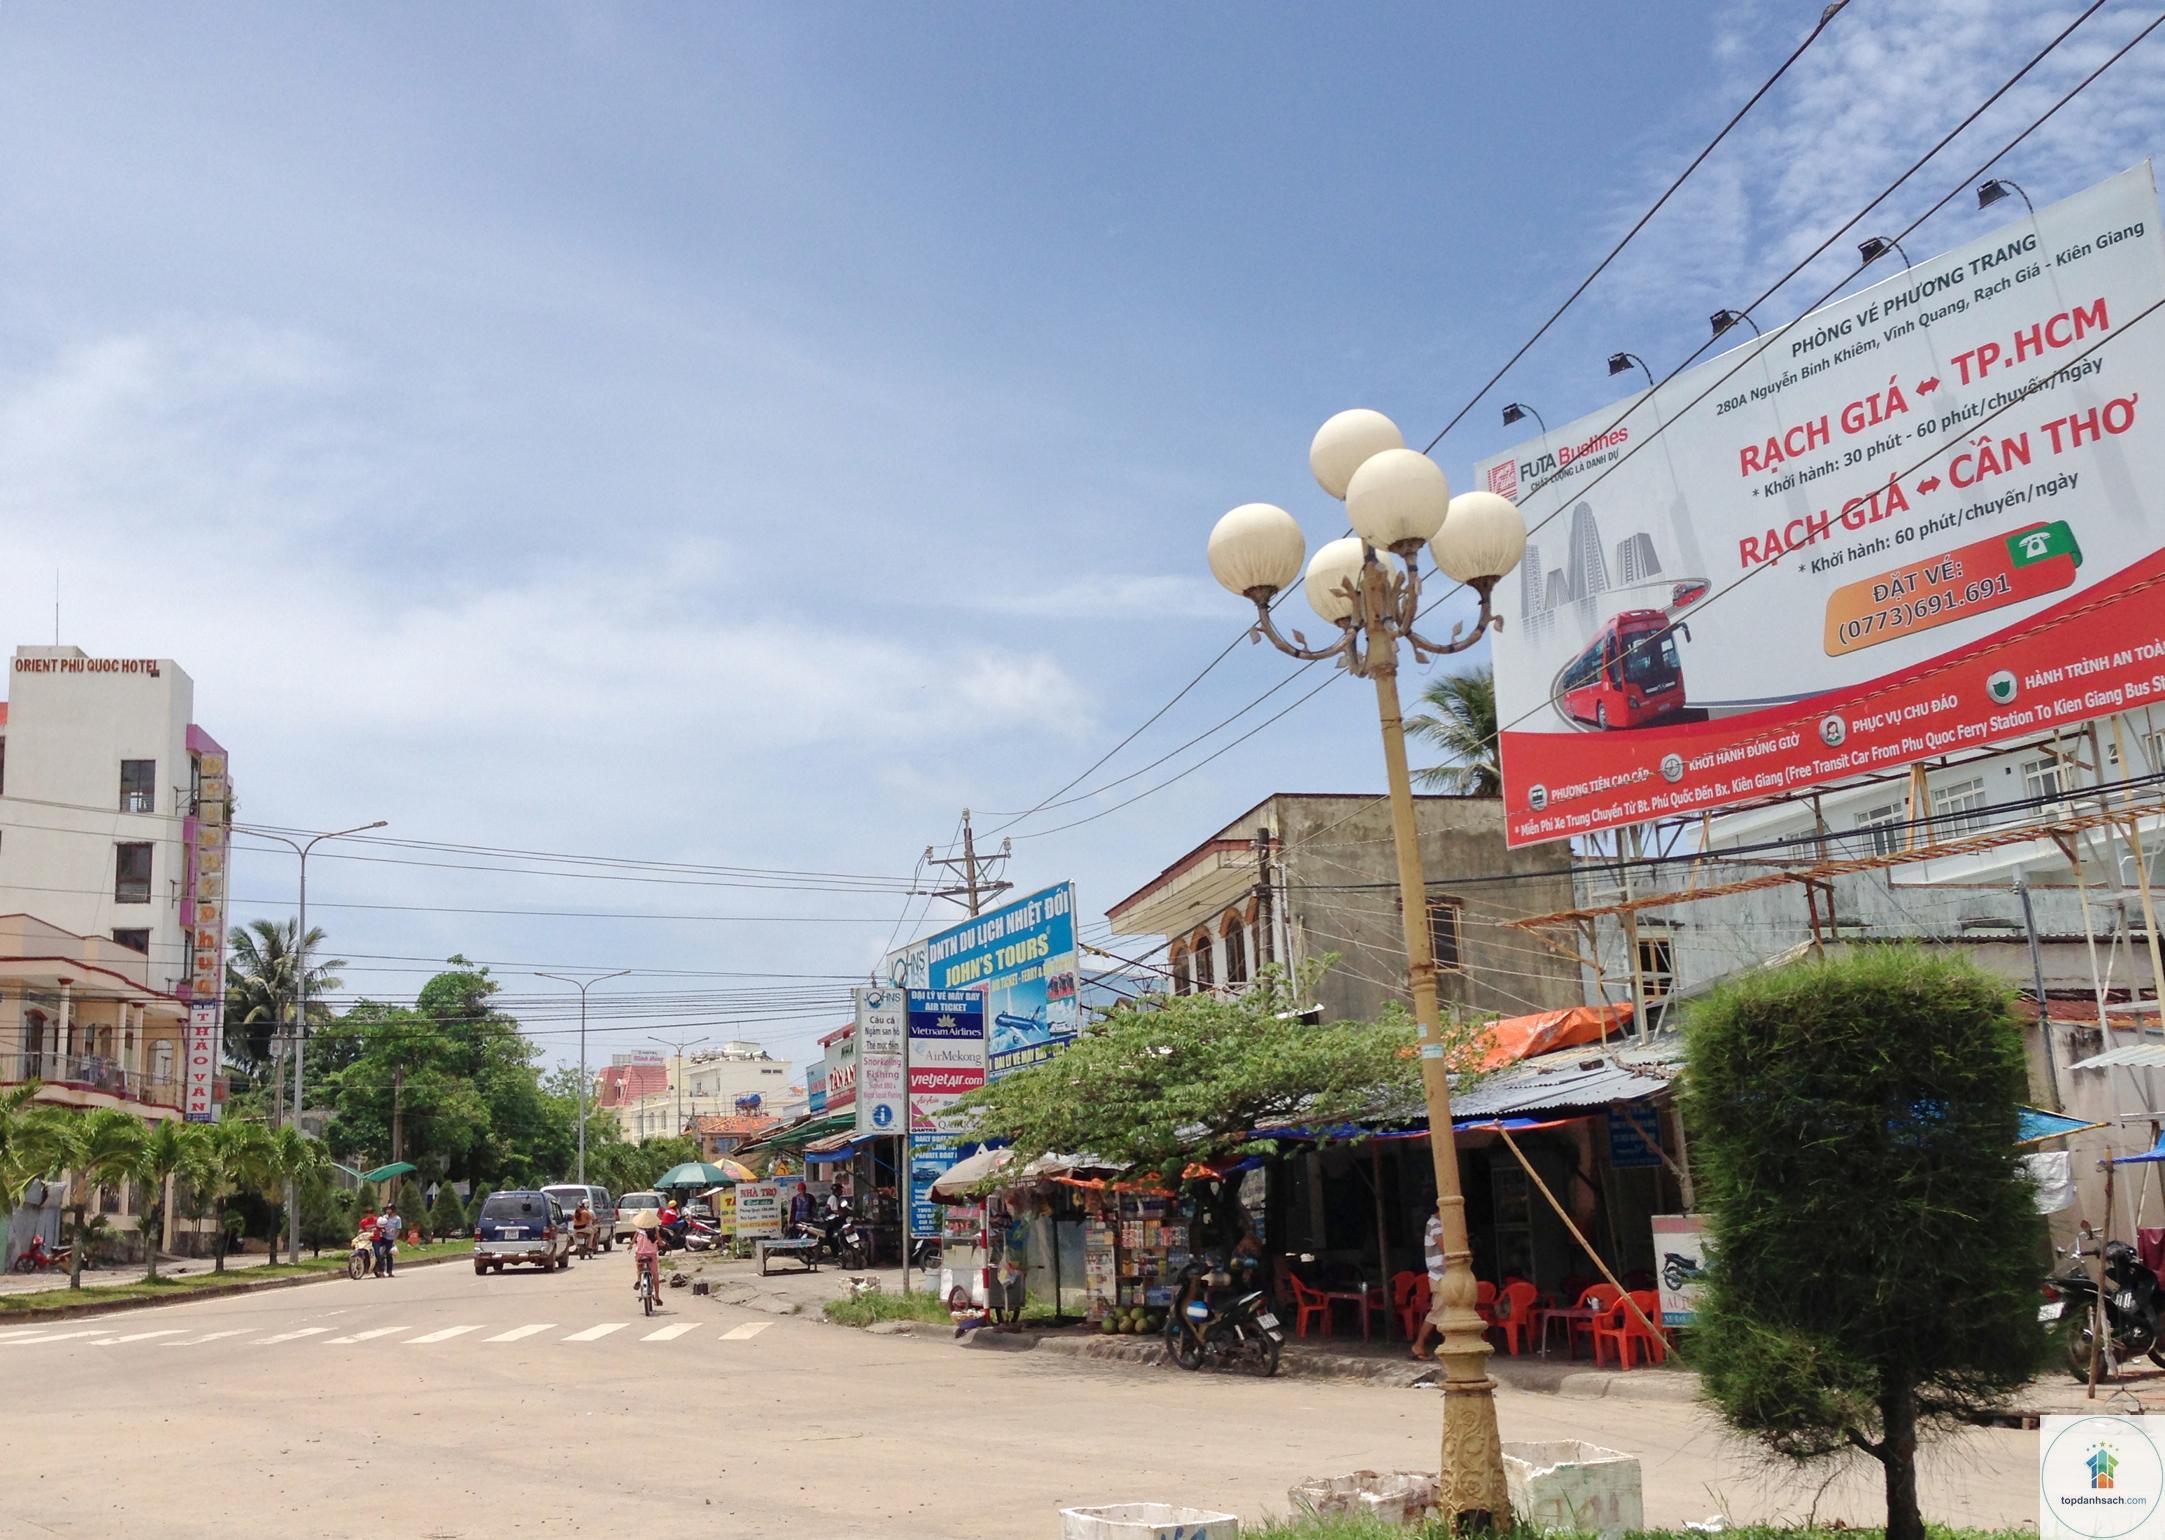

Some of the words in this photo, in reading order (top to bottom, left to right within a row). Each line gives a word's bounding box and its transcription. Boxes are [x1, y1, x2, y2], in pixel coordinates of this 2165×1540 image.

[1715, 393, 1748, 416] 280A
[1750, 370, 1798, 402] Nguyễn
[1834, 340, 1880, 366] Khiêm,
[1918, 298, 1970, 328] Quang,
[1974, 276, 2011, 303] Rạch
[2015, 262, 2041, 284] Giá
[2056, 243, 2092, 267] Kiên
[2095, 222, 2145, 250] Giang
[1792, 318, 1852, 358] PHÒNG
[1856, 301, 1879, 328] VÉ
[1883, 268, 1964, 317] PHƯƠNG
[1969, 233, 2037, 277] TRANG
[1739, 415, 1831, 478] RẠCH
[1840, 373, 1909, 435] GIÁ
[1951, 297, 2110, 386] TP.HCM
[1520, 453, 1557, 482] FUTA
[1558, 427, 1629, 467] Buslines
[1586, 454, 1607, 471] DANH
[1739, 509, 1831, 569] RẠCH
[1841, 472, 1910, 531] GIÁ
[1948, 432, 2031, 489] CẦN
[2040, 393, 2139, 455] THƠ
[1764, 475, 1795, 498] Khởi
[1799, 460, 1840, 485] hành:
[1843, 448, 1863, 466] 30
[1867, 433, 1902, 461] phút
[1917, 419, 1937, 438] 60
[1811, 552, 1844, 574] Khởi
[1847, 536, 1891, 562] hành:
[1895, 527, 1915, 546] 60
[1872, 571, 1917, 604] ĐẶT
[1923, 554, 1963, 586] VÉ:
[1837, 573, 2012, 645] (0773)691.691
[15, 658, 58, 673] ORIENT
[60, 658, 84, 673] PHU
[87, 658, 119, 673] QUOC
[121, 659, 160, 674] HOTEL
[2025, 669, 2063, 689] HÀNH
[2065, 656, 2110, 679] TRÌNH
[2112, 650, 2133, 668] AN
[2134, 638, 2165, 661] TOÀ
[1852, 714, 1884, 734] PHỤC
[1886, 709, 1902, 727] VỤ
[1904, 702, 1929, 720] CHU
[1931, 693, 1958, 713] ĐÁO
[1554, 817, 1565, 828] Xe
[1567, 811, 1591, 828] Trung
[1624, 800, 1636, 815] Từ
[1651, 793, 1669, 810] Phú
[1670, 788, 1694, 808] Quốc
[1715, 783, 1730, 797] Bx.
[1732, 776, 1753, 793] Kiên
[1755, 770, 1783, 788] Giang
[1786, 765, 1812, 784] (Free
[1812, 754, 1850, 775] Transit
[1851, 750, 1869, 765] Car
[1872, 743, 1900, 760] From
[1902, 737, 1924, 754] Phu
[1925, 731, 1956, 751] Quoc
[1957, 721, 1987, 740] Ferry
[1990, 710, 2034, 732] Station
[2035, 704, 2052, 719] To
[2054, 697, 2083, 716] Kien
[2085, 686, 2123, 708] Giang
[2125, 682, 2150, 698] Bus
[1747, 740, 1777, 758] ĐÚNG
[1779, 731, 1800, 750] GIỜ
[1551, 781, 1588, 801] PHƯƠNG
[929, 934, 958, 964] DNTN
[960, 927, 976, 953] DU
[977, 916, 1004, 949] LỊCH
[1006, 900, 1042, 936] NHIỆT
[1044, 888, 1070, 920] ĐỚI
[945, 952, 994, 988] JOHN'S
[995, 932, 1049, 970] TOURS
[939, 1003, 967, 1012] TICKET
